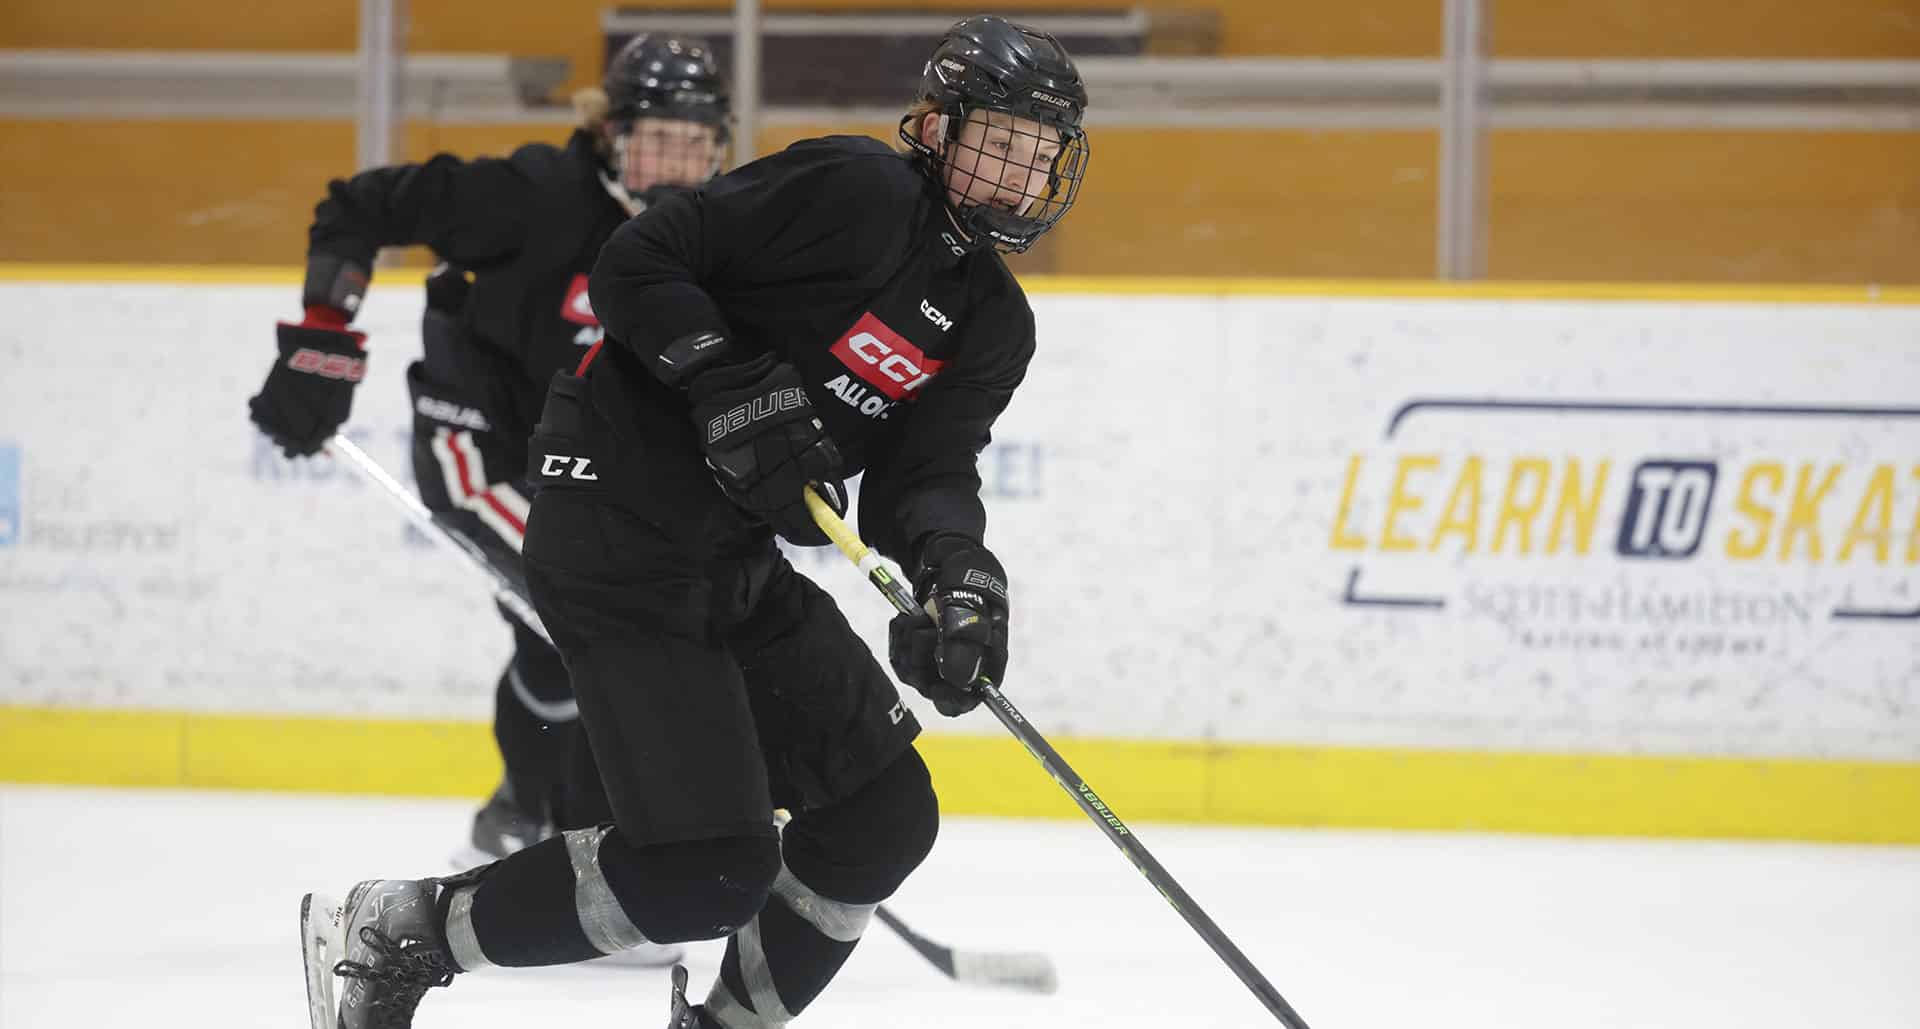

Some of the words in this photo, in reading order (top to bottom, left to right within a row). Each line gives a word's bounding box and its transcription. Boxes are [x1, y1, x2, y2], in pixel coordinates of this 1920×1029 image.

[920, 298, 953, 332] CCM
[1328, 455, 1610, 557] LEARN
[1632, 467, 1708, 556] TO
